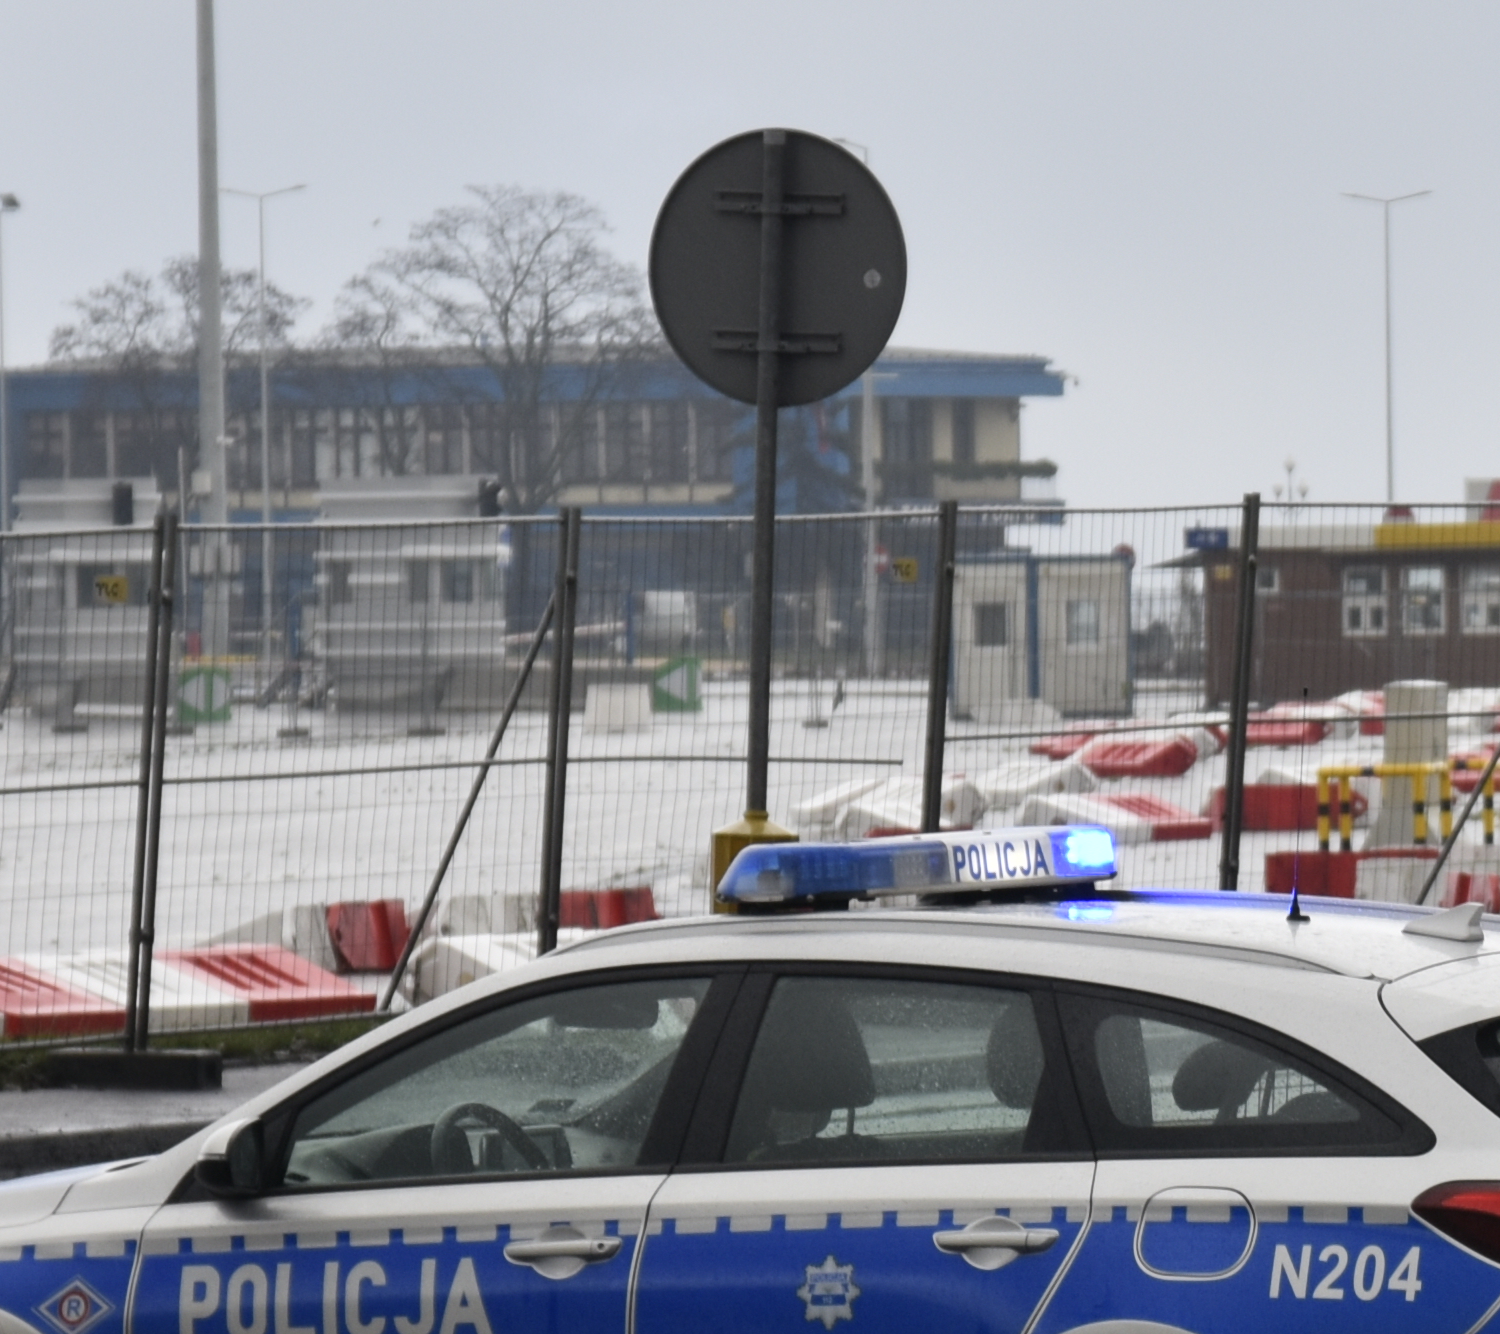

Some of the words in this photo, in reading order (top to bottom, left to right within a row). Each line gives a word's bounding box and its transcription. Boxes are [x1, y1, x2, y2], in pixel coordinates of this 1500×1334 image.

[952, 839, 1050, 883] POLICJA
[1269, 1244, 1422, 1302] N204
[66, 1299, 81, 1318] R
